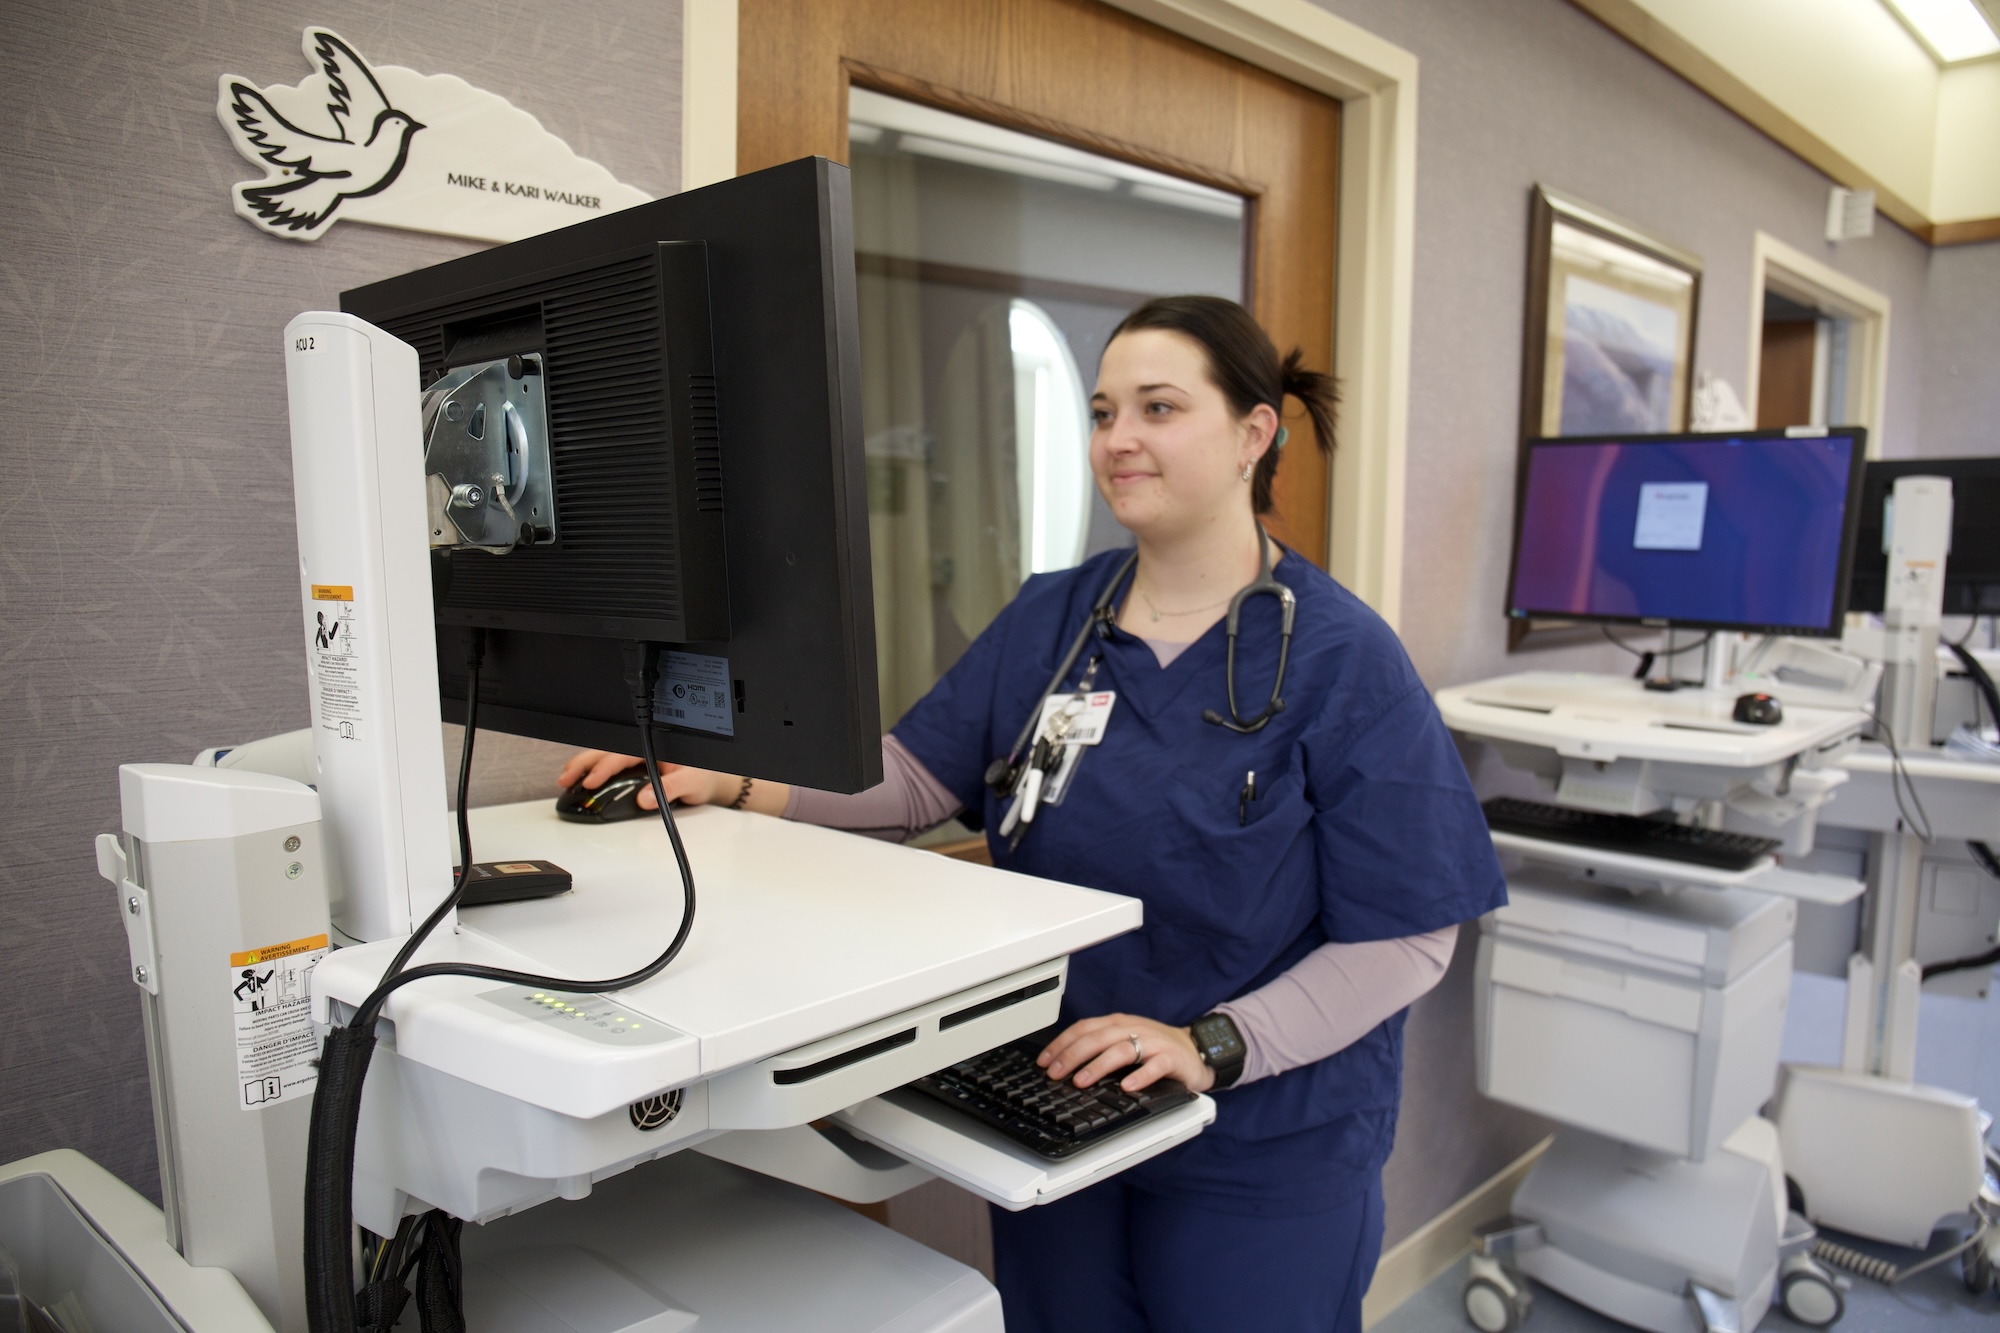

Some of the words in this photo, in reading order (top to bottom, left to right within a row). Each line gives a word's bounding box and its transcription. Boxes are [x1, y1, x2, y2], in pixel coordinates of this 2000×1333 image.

[447, 172, 486, 191] MIKE
[491, 181, 500, 193] &
[504, 182, 540, 199] KARI
[544, 189, 601, 209] WALKER
[295, 338, 308, 352] ACU
[309, 337, 315, 350] 2
[687, 684, 706, 692] HDMI
[260, 944, 291, 955] WARNING
[260, 945, 310, 961] AVERTISSEMENT
[256, 1006, 281, 1016] IMPACT
[253, 1040, 282, 1053] DANGER
[282, 1031, 314, 1044] D'IMPACT
